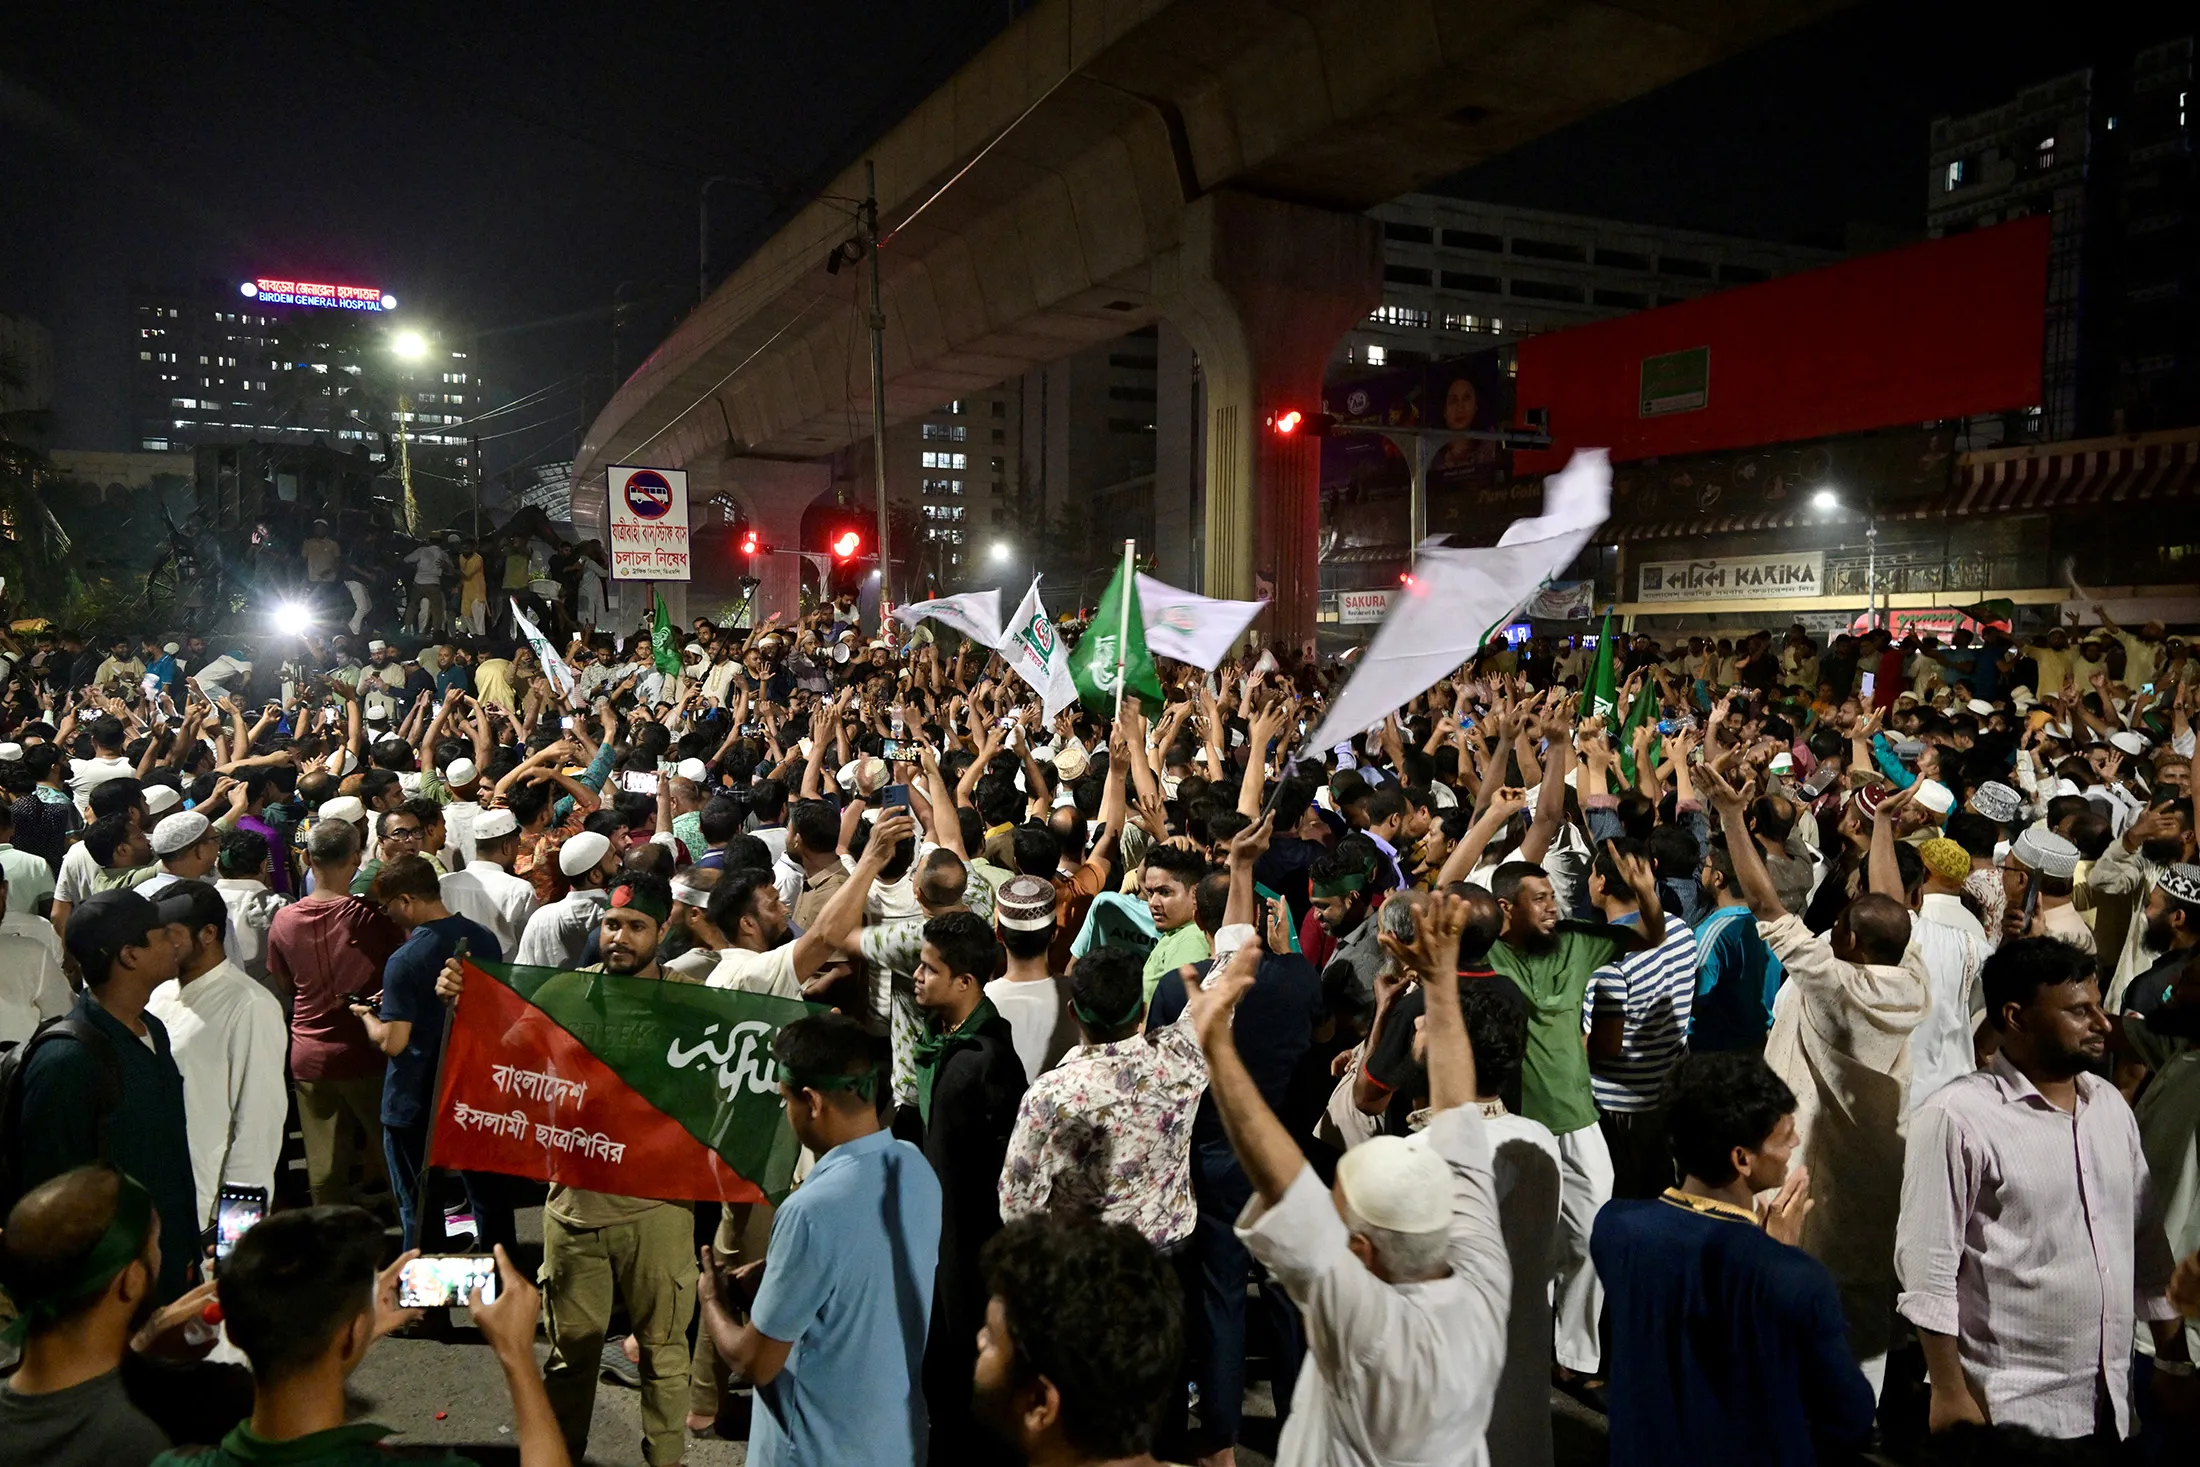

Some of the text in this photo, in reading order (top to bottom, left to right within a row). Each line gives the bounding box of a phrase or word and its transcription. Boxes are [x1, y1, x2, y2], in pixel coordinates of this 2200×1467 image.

[259, 292, 382, 311] BIRDEM GENERAL HOSPITAL
[675, 525, 688, 544] বাস
[614, 547, 688, 567] চলাচল নিষেধ
[1345, 595, 1387, 608] SAKURA
[492, 1064, 588, 1111] বাংলাদেশ
[454, 1101, 626, 1164] ইসলামী ছাত্রশিবির
